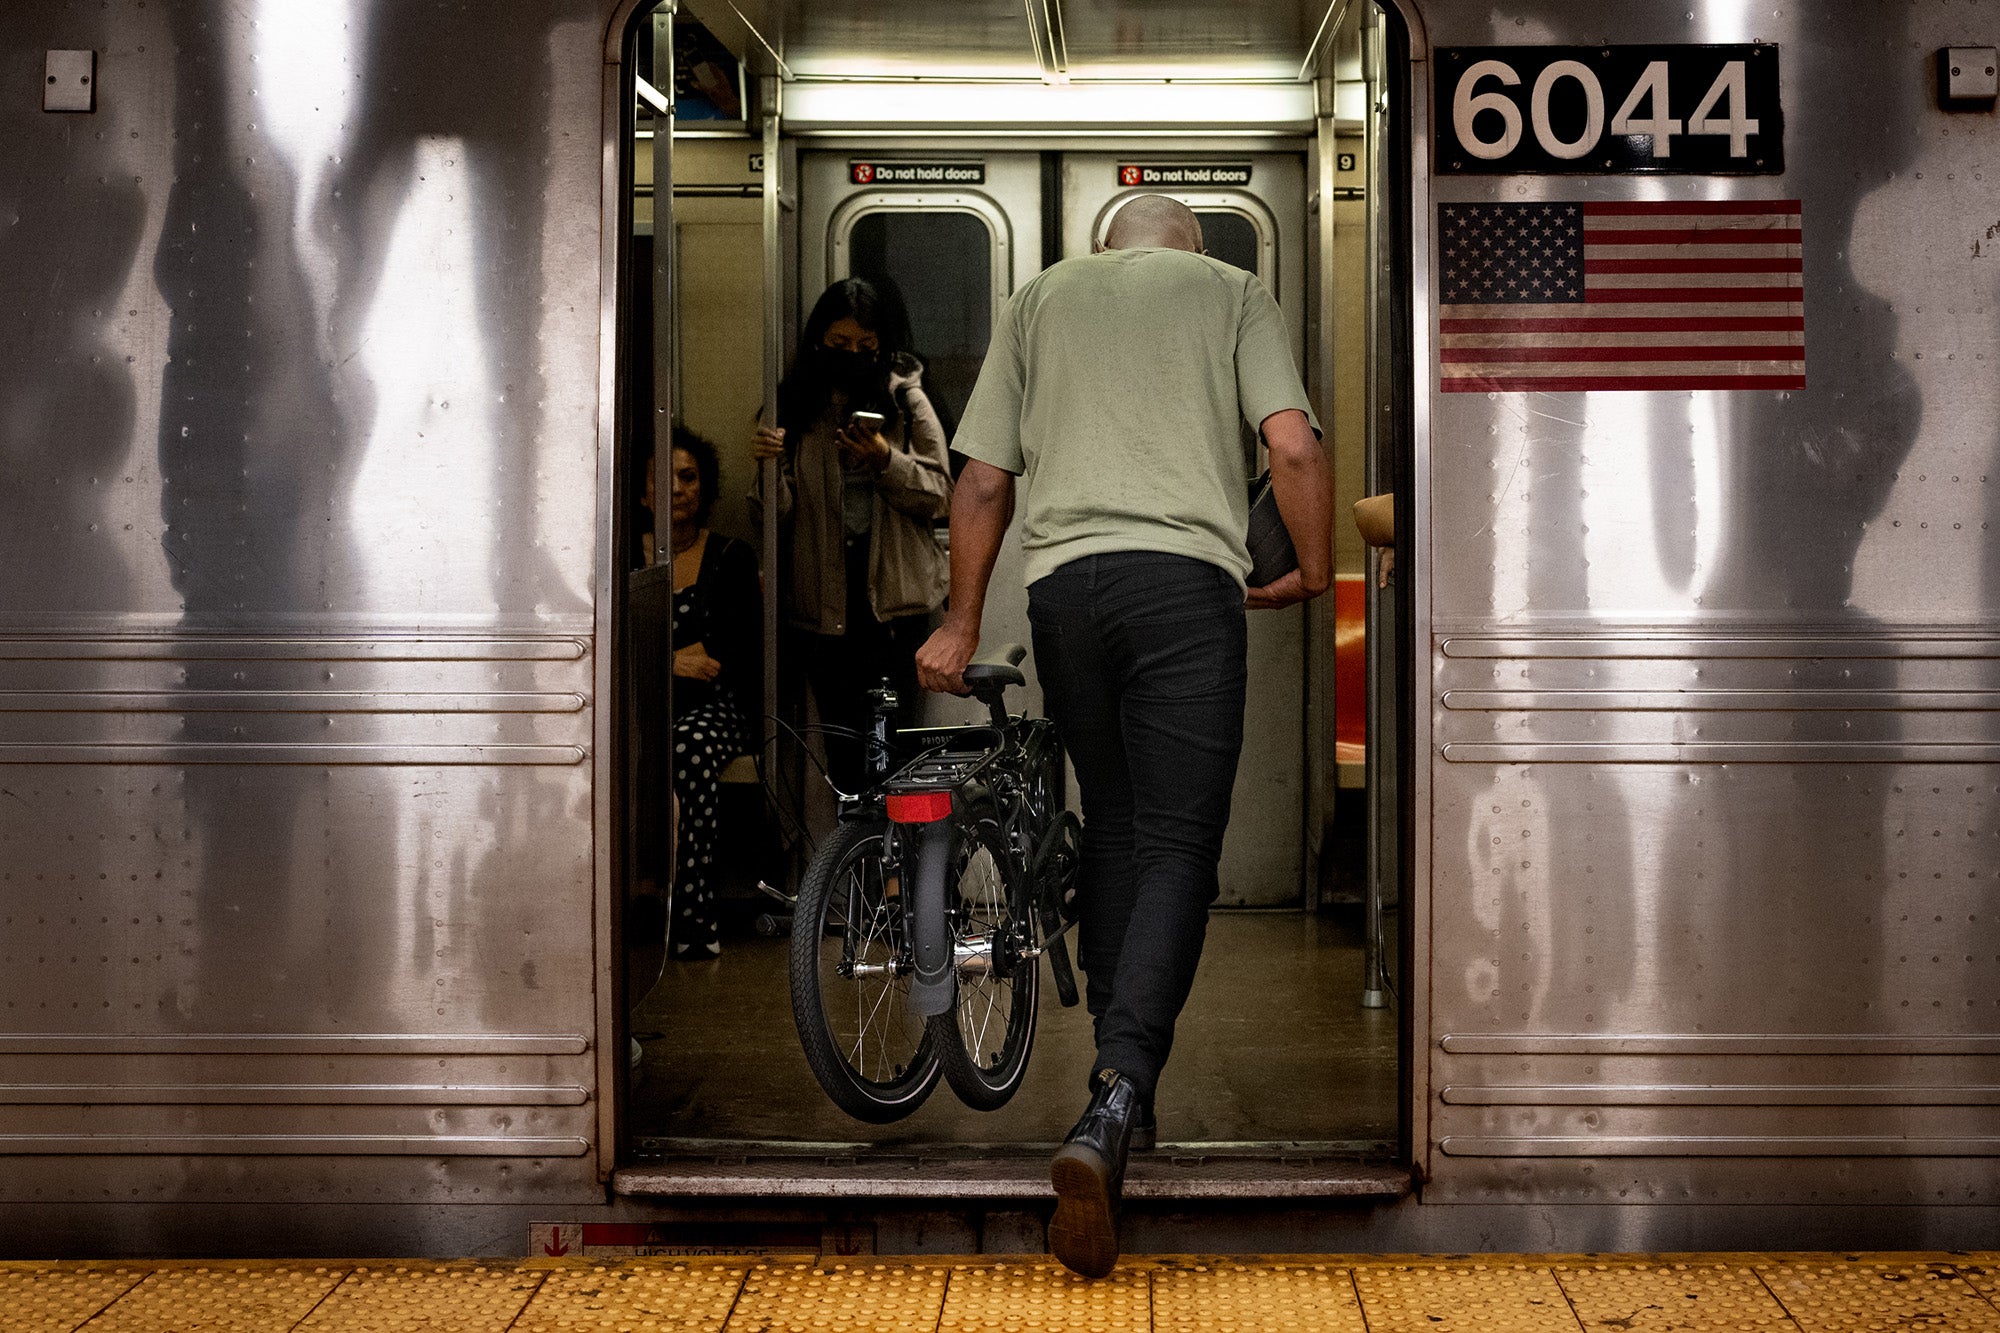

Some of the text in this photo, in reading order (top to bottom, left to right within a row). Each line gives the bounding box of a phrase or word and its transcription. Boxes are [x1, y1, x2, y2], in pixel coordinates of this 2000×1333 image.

[1452, 60, 1760, 160] 6044
[1340, 155, 1352, 170] 9
[876, 167, 981, 180] Do not hold doors
[1143, 169, 1248, 181] Do not hold doors
